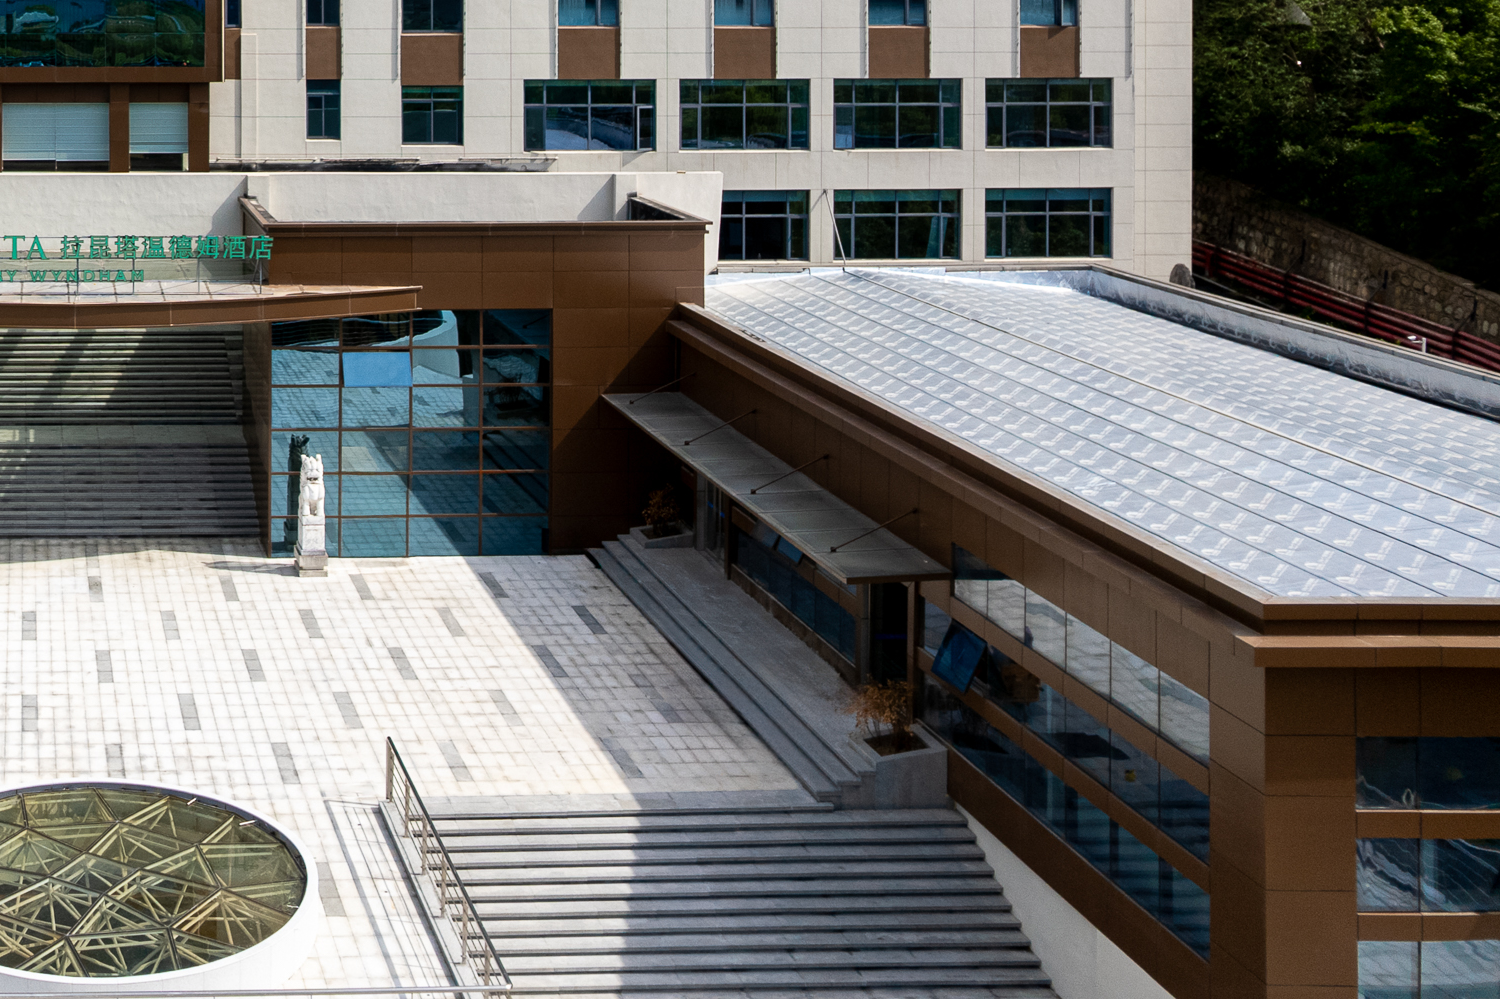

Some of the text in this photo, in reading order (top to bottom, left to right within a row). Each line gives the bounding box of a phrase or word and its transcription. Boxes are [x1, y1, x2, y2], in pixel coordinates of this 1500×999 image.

[60, 234, 274, 261] 拉昆塔温德姆酒店
[29, 269, 145, 284] WYNDHAM
